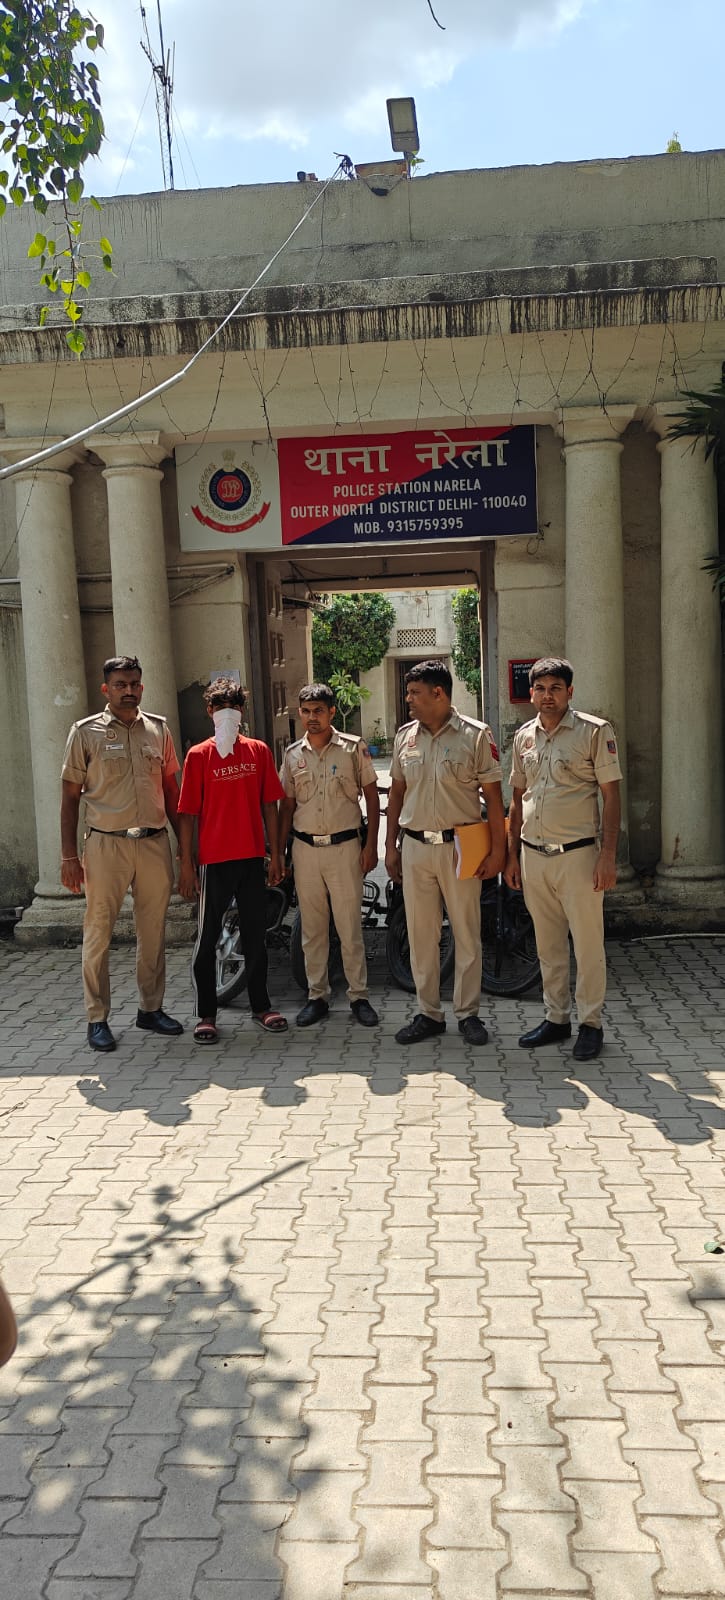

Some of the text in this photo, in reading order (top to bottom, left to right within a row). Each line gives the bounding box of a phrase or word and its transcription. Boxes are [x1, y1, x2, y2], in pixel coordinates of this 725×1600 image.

[304, 431, 510, 475] थाना नरेला
[333, 479, 481, 497] POLICE STATION NARELA
[290, 495, 527, 518] OUTER NORTH DISTRICT DELHI- 110040
[353, 517, 463, 534] MOB. 9315759395
[212, 763, 256, 777] VERSACE
